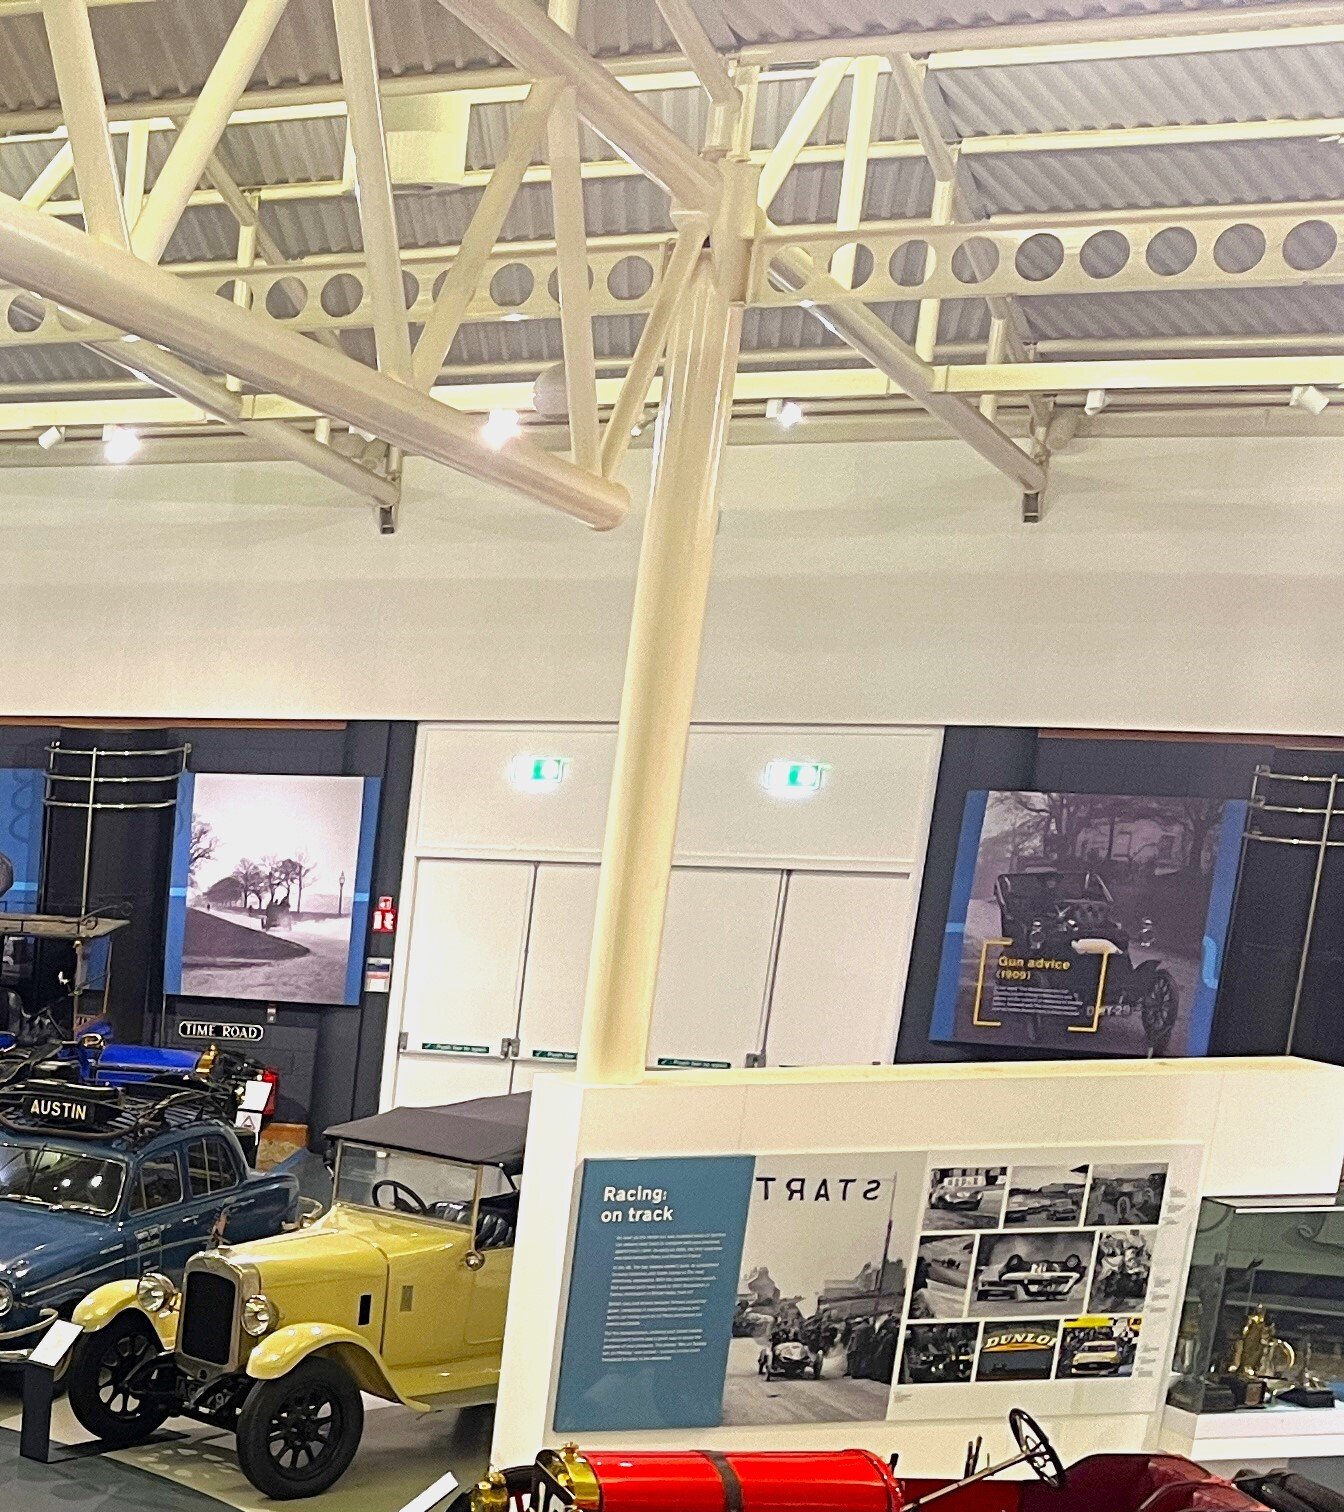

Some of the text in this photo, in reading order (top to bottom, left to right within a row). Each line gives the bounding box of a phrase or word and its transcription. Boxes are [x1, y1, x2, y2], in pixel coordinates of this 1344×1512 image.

[186, 1022, 258, 1038] TIME ROAD
[30, 1100, 87, 1121] AUSTIN
[603, 1186, 667, 1204] Racing:
[601, 1206, 674, 1222] on track
